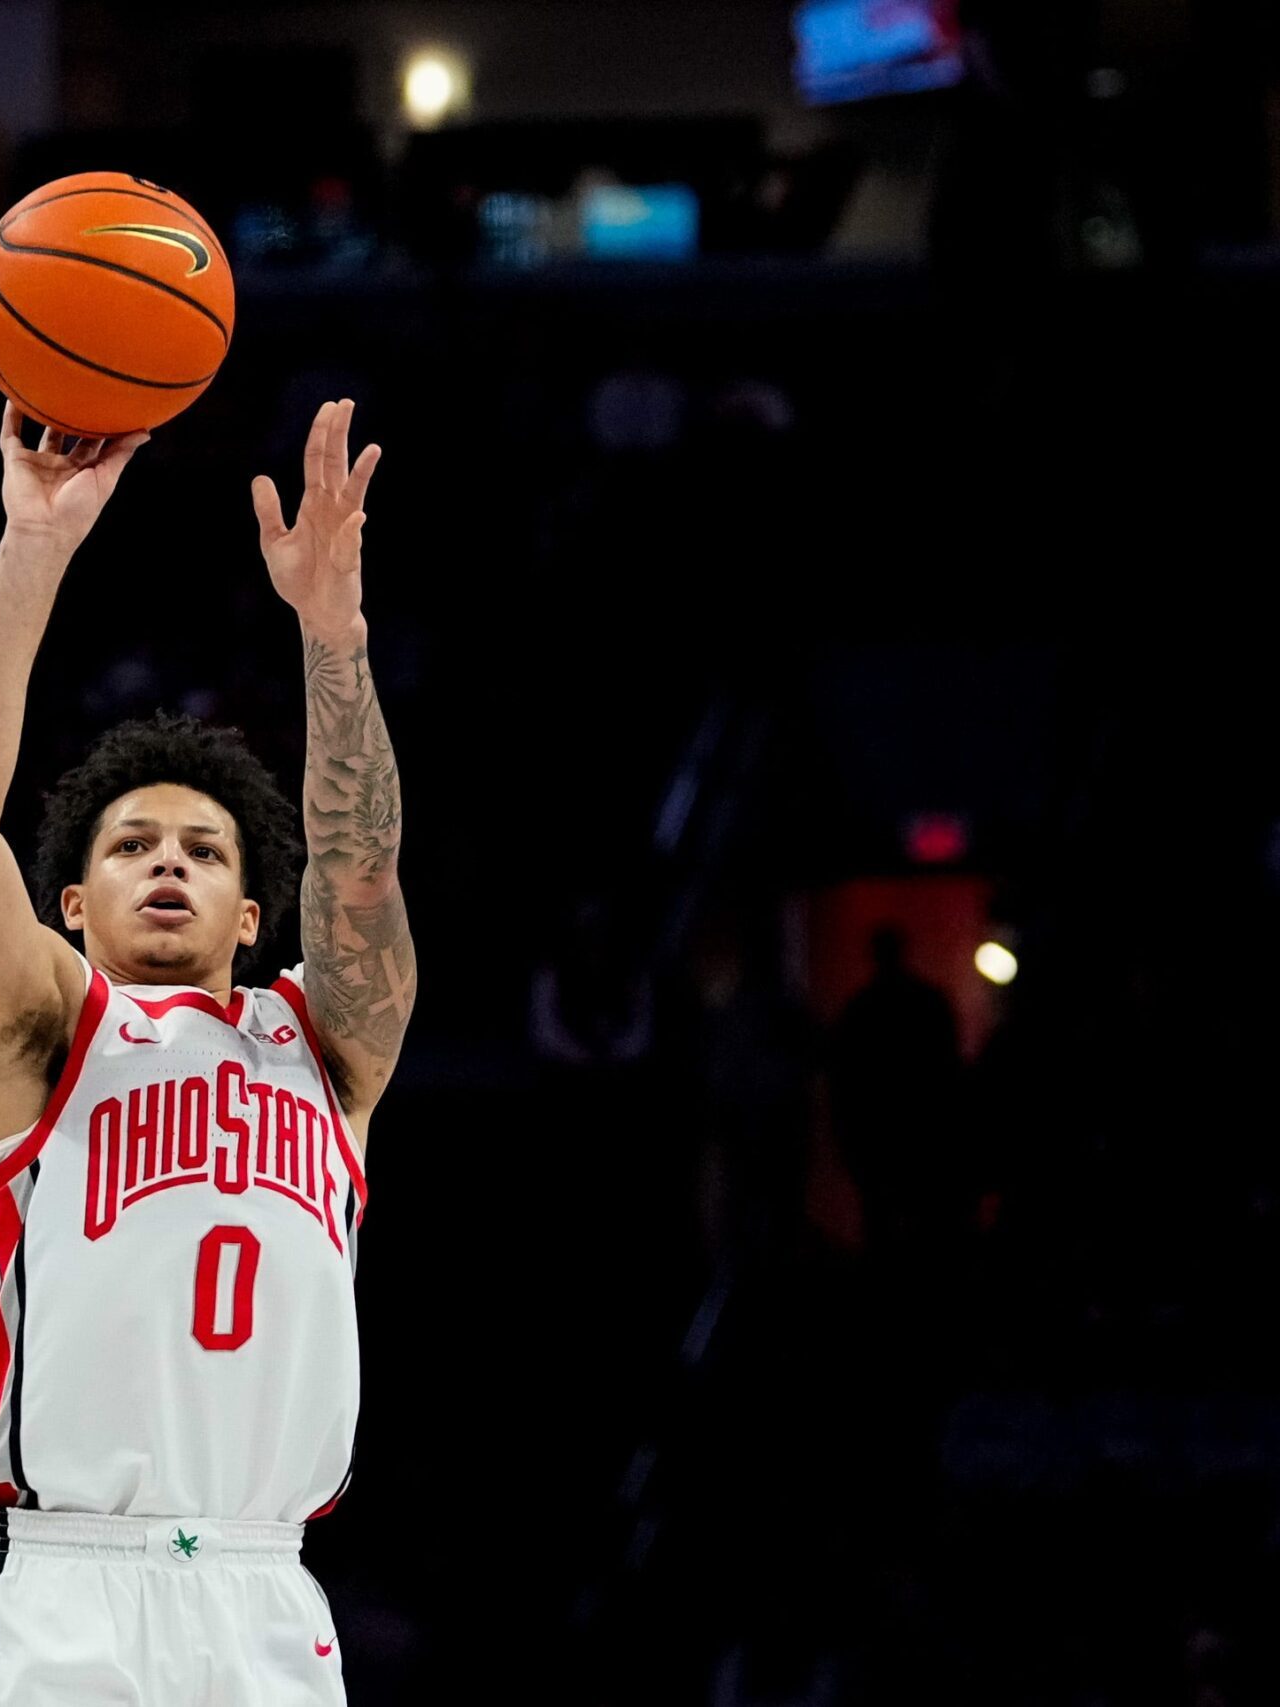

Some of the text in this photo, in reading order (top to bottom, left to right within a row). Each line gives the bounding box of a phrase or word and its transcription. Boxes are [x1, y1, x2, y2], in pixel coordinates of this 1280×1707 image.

[83, 1059, 344, 1258] OHIO STATE
[191, 1225, 262, 1352] 0
